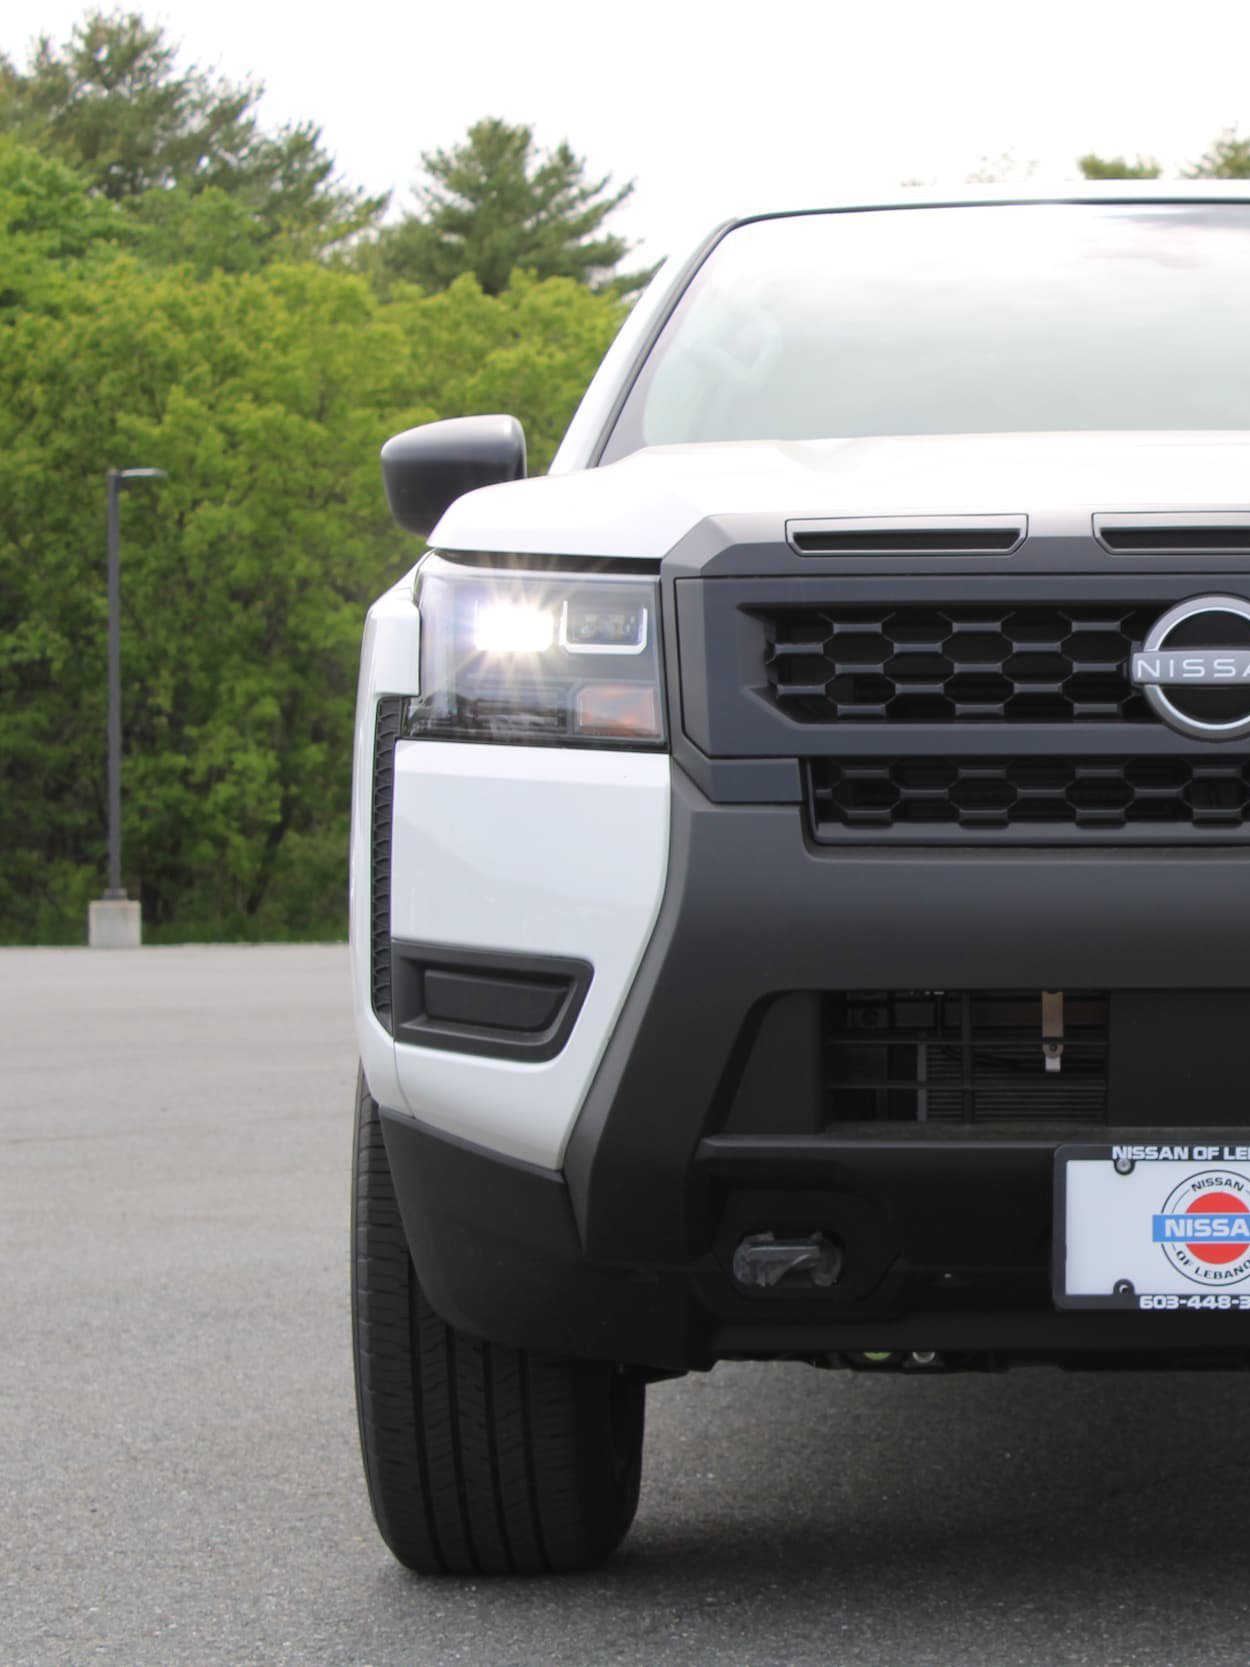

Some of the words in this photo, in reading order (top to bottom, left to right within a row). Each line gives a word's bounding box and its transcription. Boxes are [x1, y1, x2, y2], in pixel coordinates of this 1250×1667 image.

[1112, 1146, 1189, 1160] NISSAN
[1192, 1146, 1220, 1160] OF
[1191, 1177, 1244, 1192] NISSAN
[1176, 1250, 1194, 1267] OF
